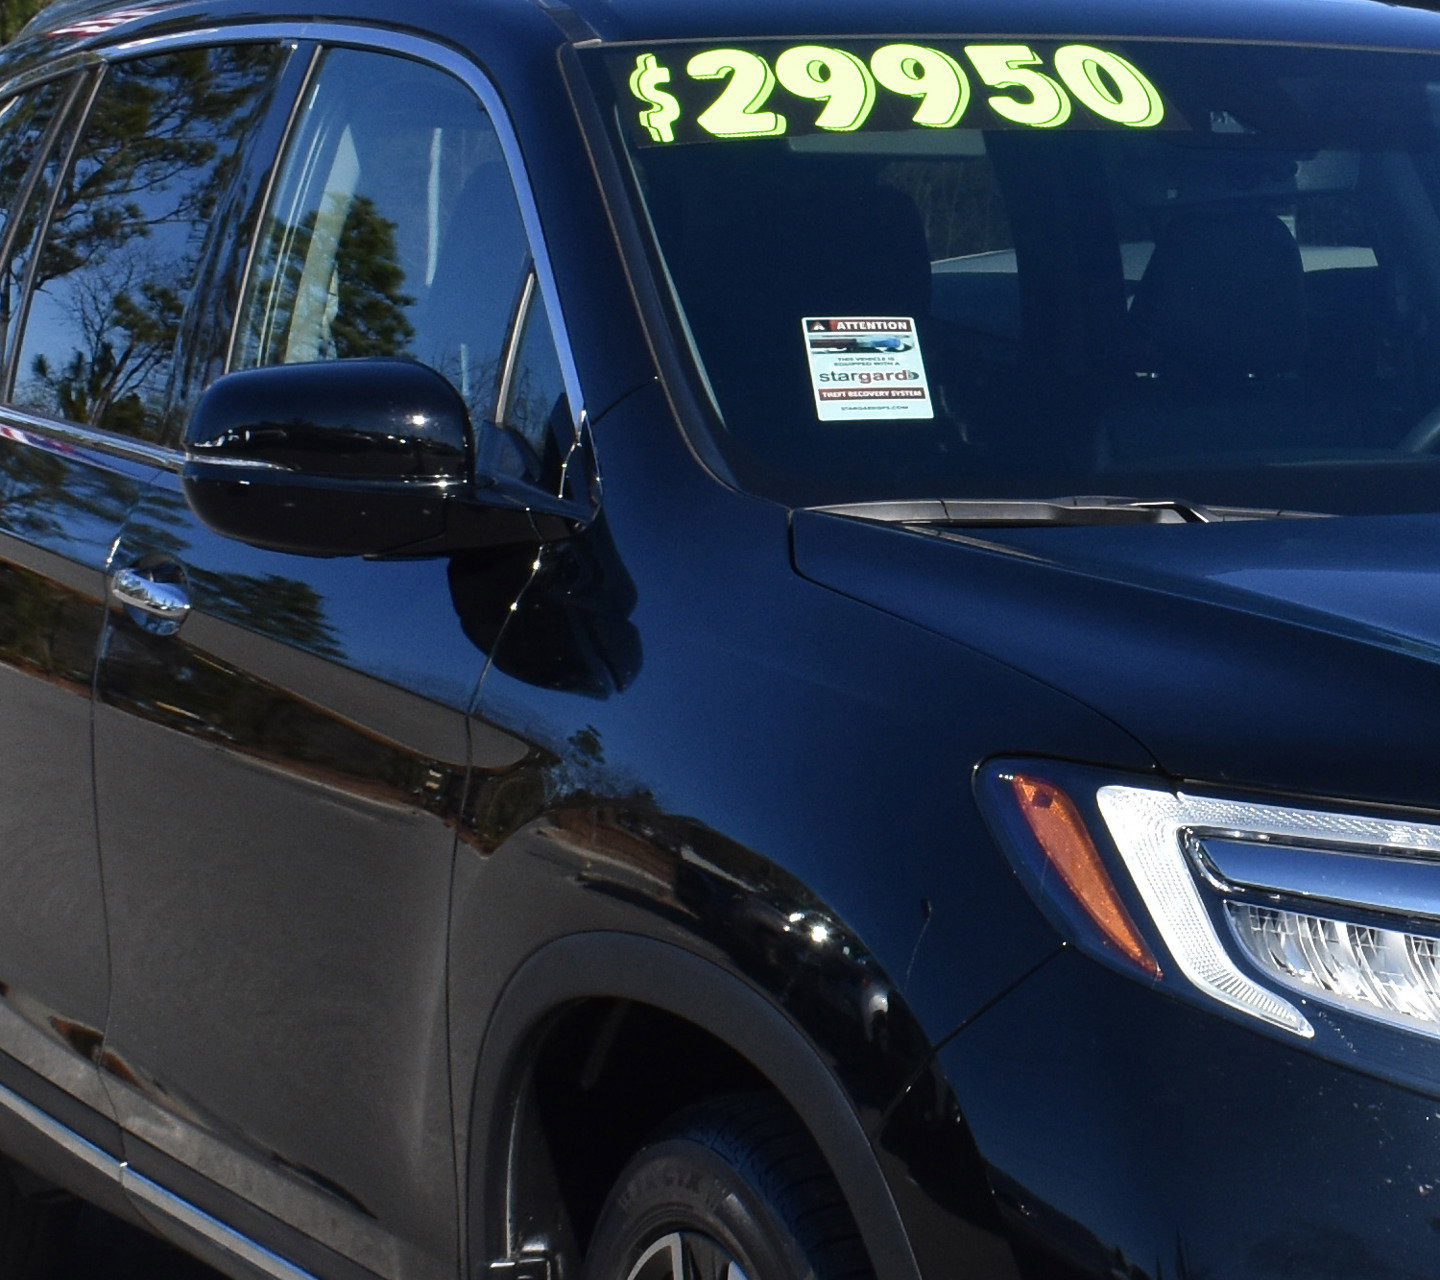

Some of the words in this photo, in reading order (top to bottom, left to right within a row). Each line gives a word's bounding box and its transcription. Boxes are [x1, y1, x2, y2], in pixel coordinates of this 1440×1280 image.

[628, 42, 1165, 143] $29950
[836, 321, 908, 330] ATTENTION
[819, 369, 908, 384] stargard
